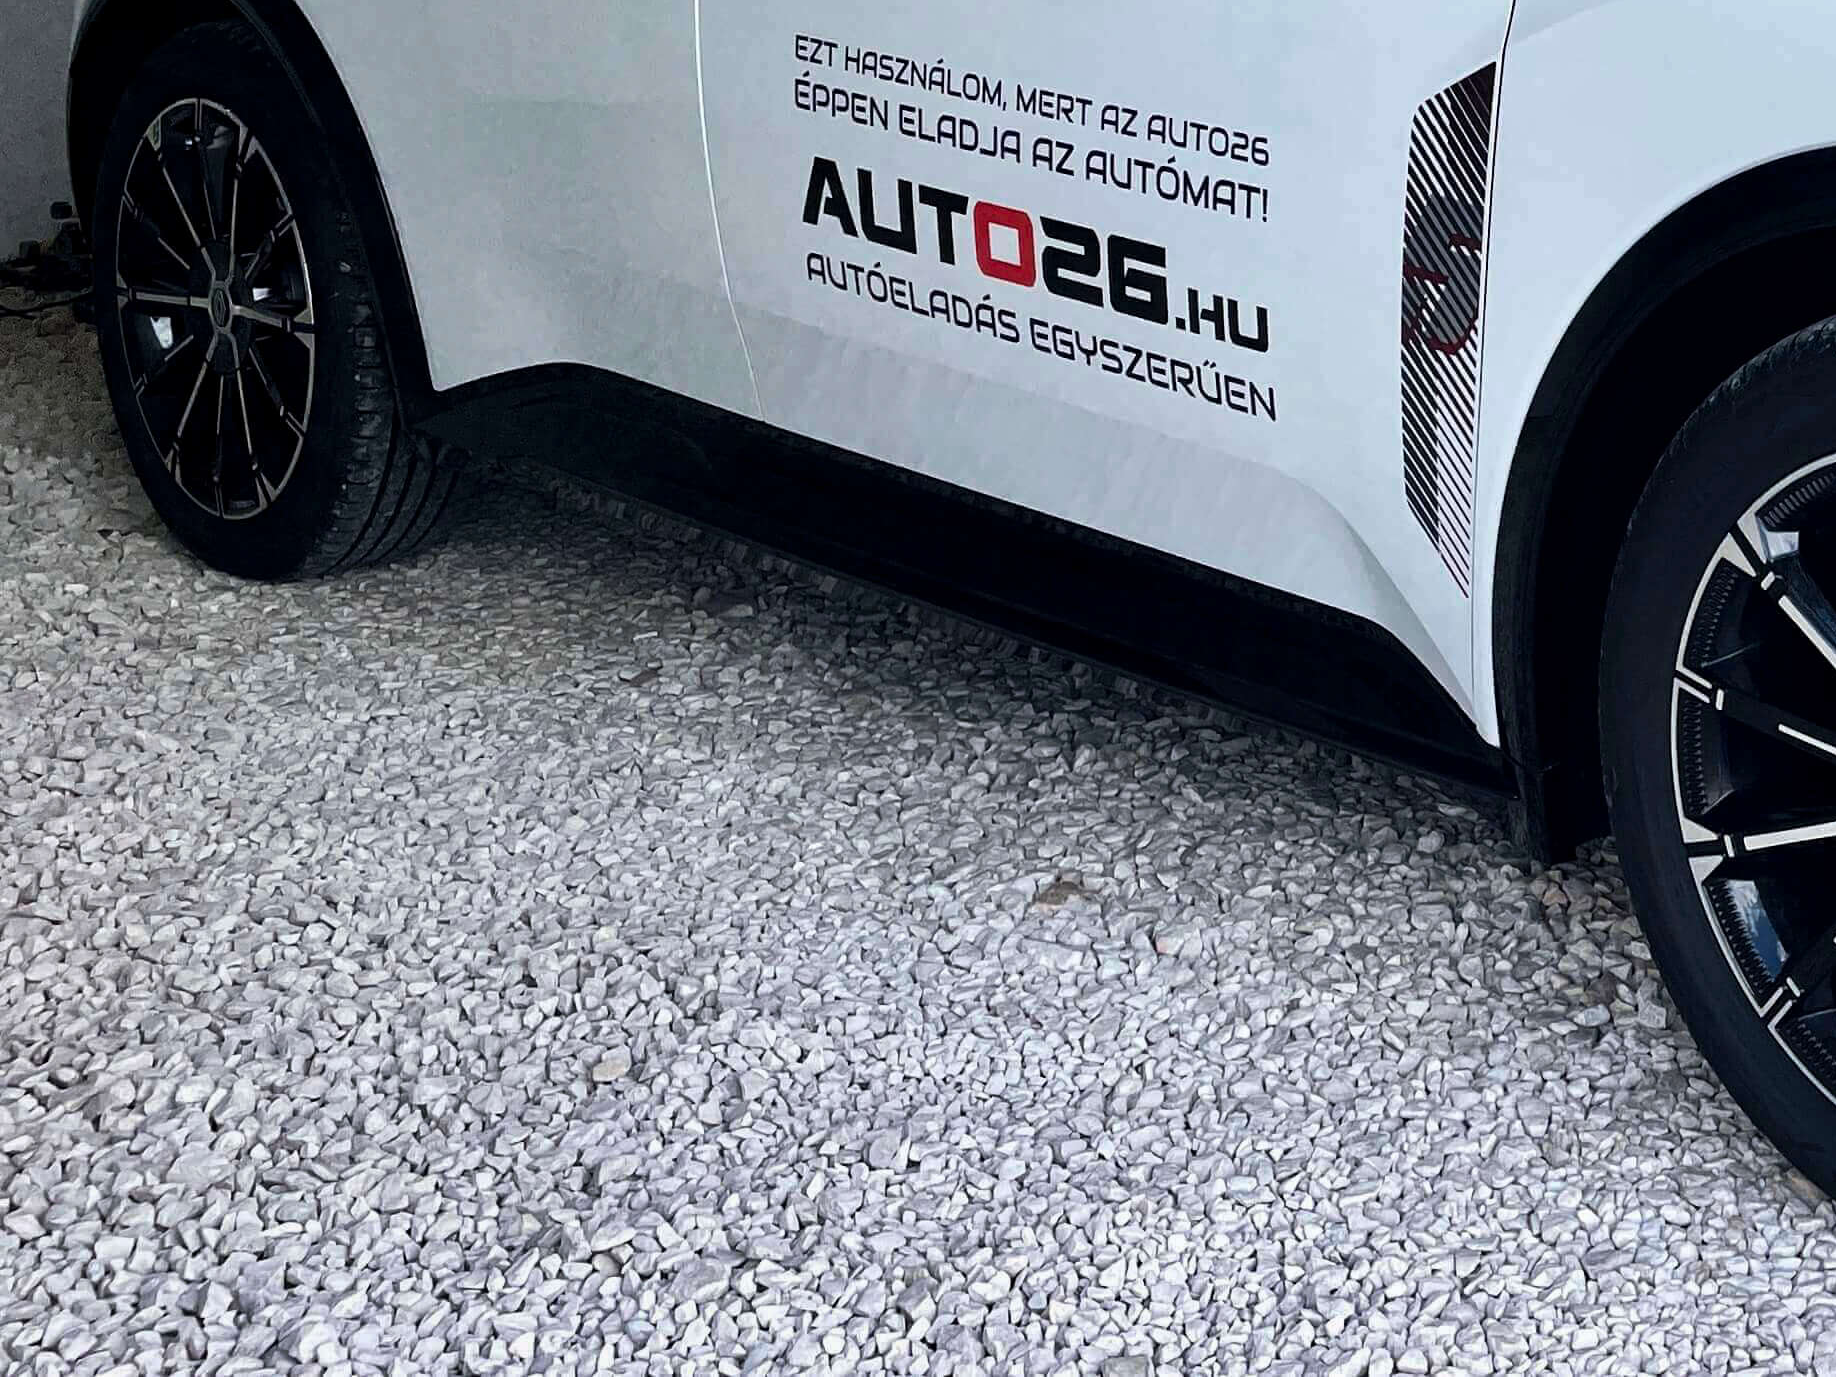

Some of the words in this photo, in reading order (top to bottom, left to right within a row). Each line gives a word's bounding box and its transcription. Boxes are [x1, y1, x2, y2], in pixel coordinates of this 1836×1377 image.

[794, 70, 889, 131] ÉPPEN
[898, 103, 1021, 164] ELADJA
[1032, 137, 1075, 177] AZ
[1085, 149, 1269, 223] AUTÓMAT!
[795, 34, 839, 68] EZT
[844, 45, 1007, 111] HASZNÁLOM,
[1015, 84, 1093, 127] MERT
[1100, 104, 1138, 138] AZ
[1147, 114, 1270, 167] AUTO26
[802, 155, 1269, 354] AUTO26.HU
[806, 252, 1020, 344] AUTÓELADÁS
[1029, 317, 1277, 422] EGYSZERŰEN
